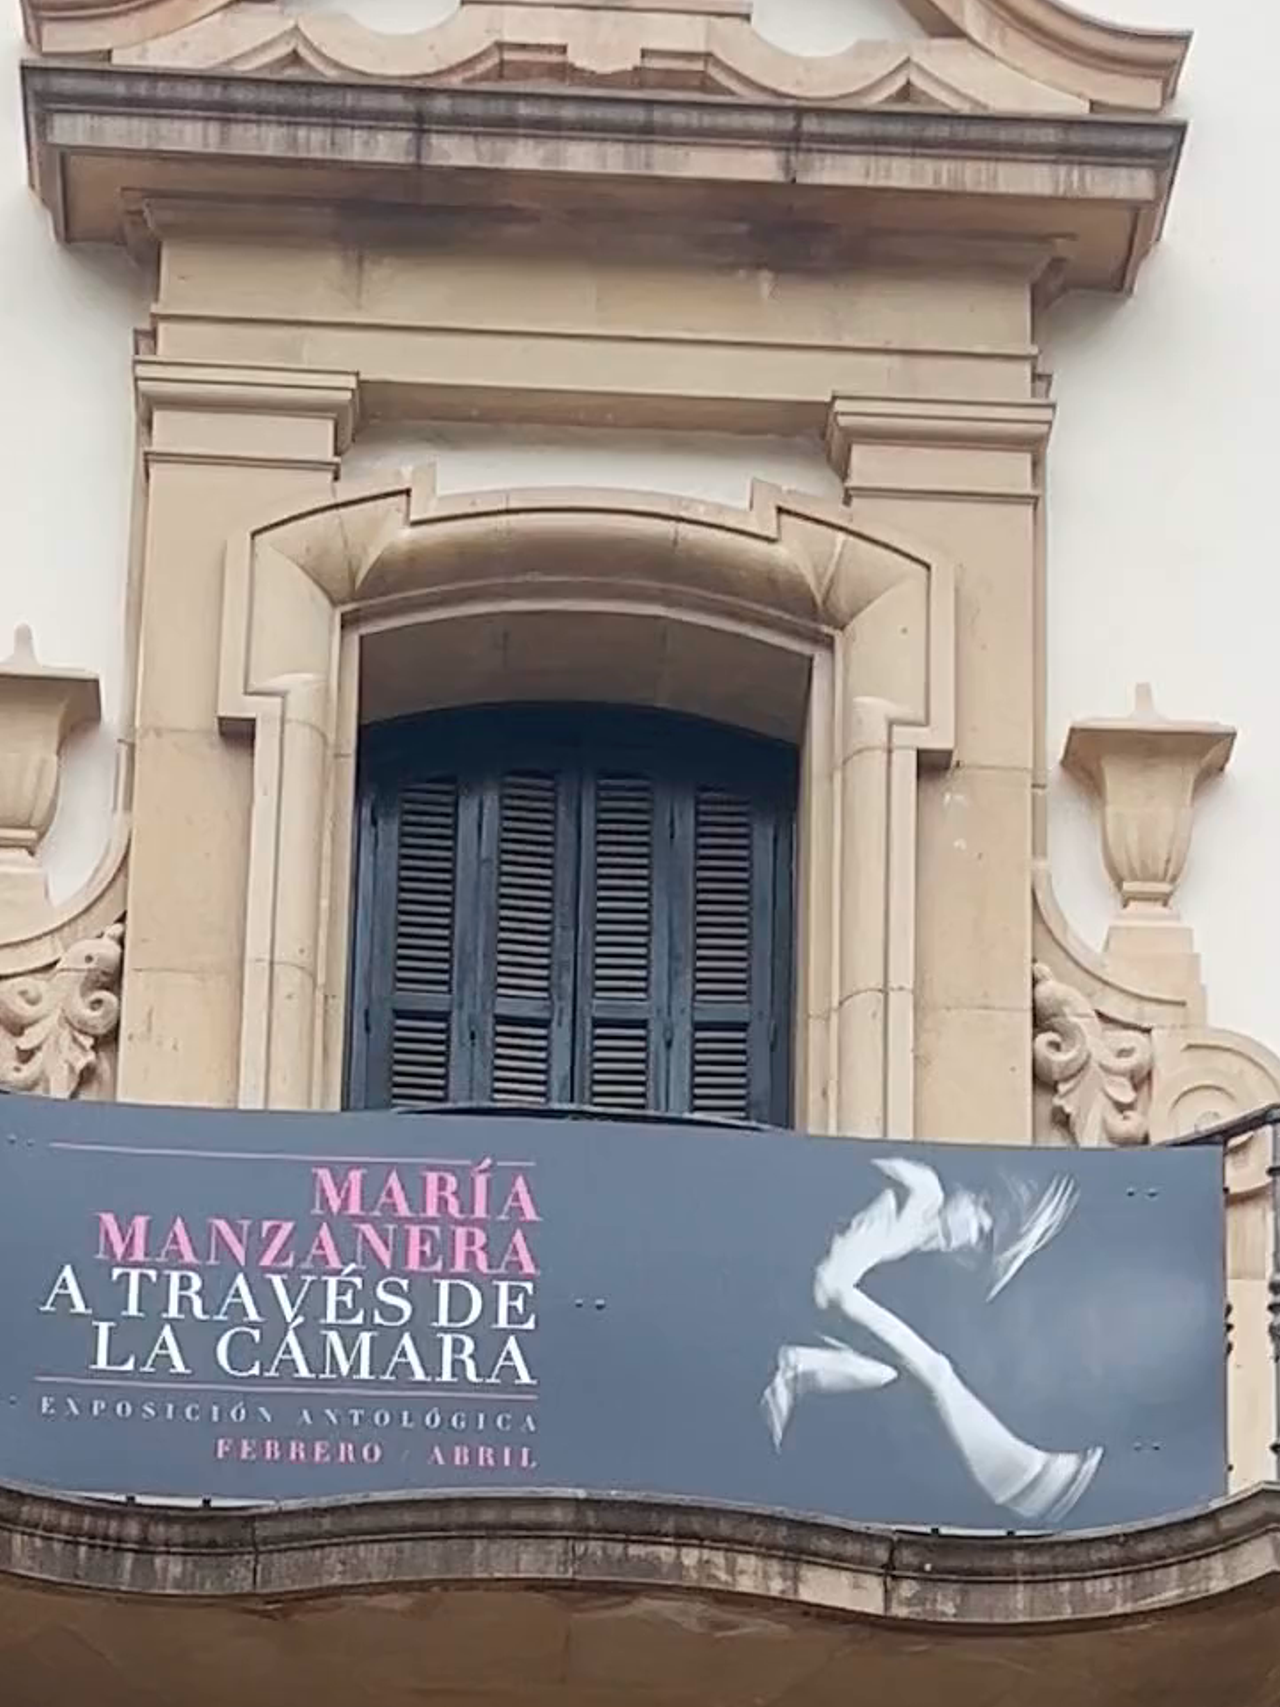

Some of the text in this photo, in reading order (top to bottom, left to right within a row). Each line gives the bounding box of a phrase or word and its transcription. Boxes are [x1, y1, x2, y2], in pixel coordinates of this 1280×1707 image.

[310, 1157, 543, 1222] MARÍA
[92, 1210, 541, 1276] MANZANERA
[39, 1262, 537, 1330] A TRAVÉS DE
[88, 1314, 538, 1385] LA CÁMARA
[40, 1395, 537, 1432] EXPOSICIÓN ANTOLÓGICA
[214, 1438, 383, 1463] FEBRERO
[427, 1445, 538, 1468] ABRIL
